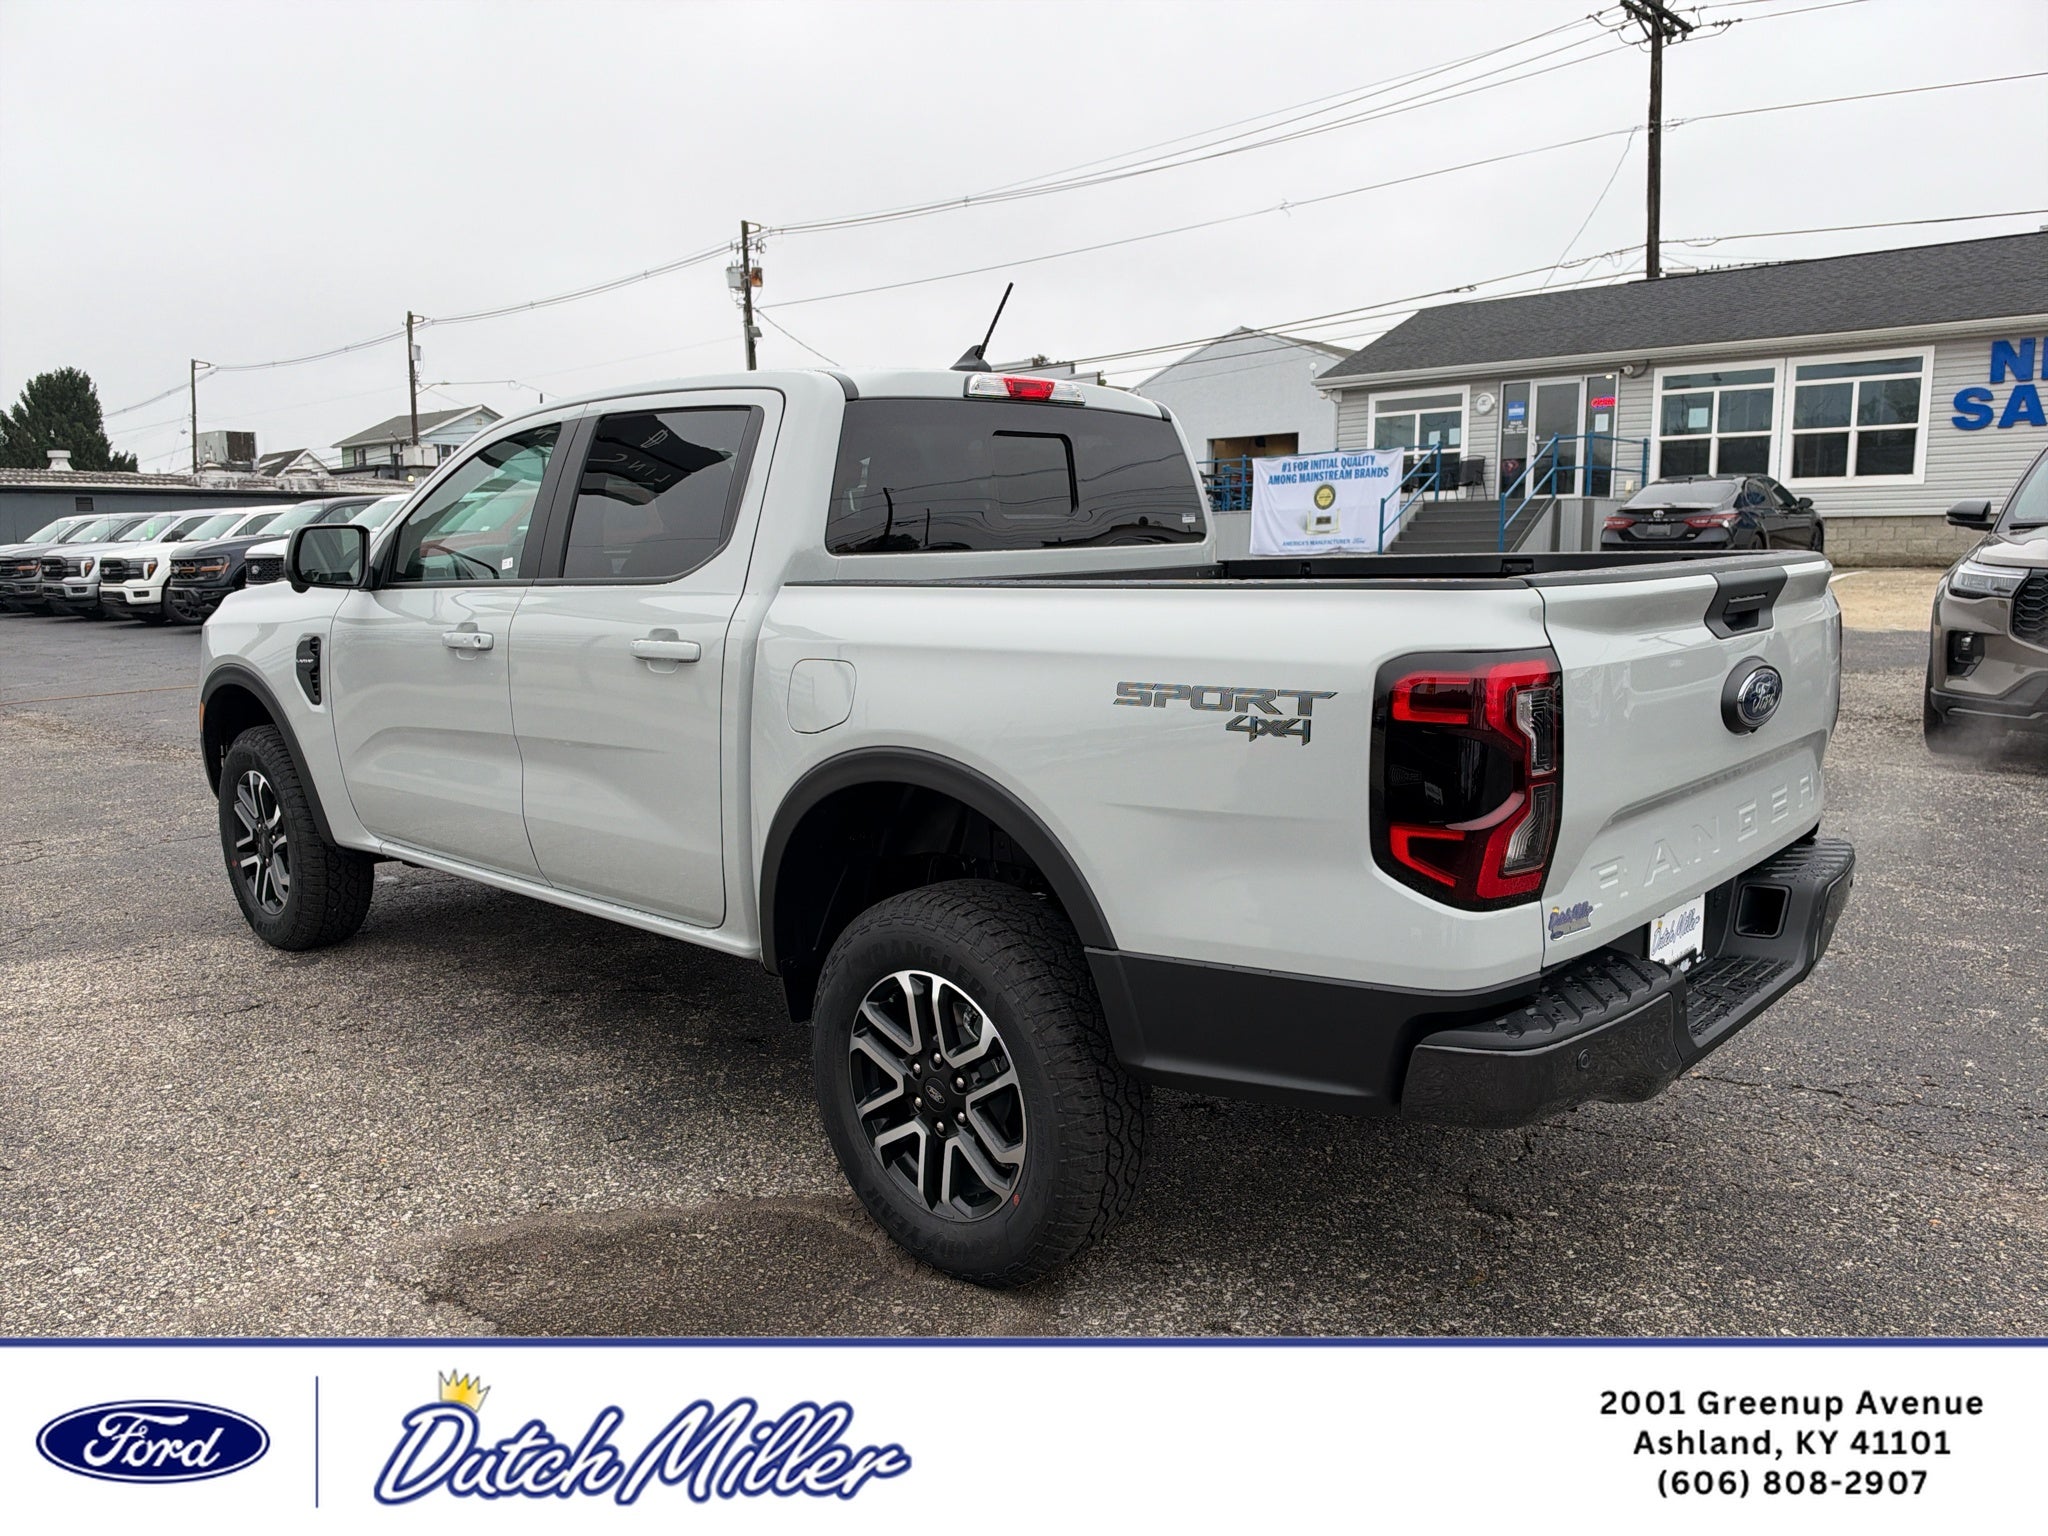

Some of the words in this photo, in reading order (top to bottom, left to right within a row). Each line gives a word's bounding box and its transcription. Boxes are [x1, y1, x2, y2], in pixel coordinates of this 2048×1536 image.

[1990, 337, 2048, 385] N
[1267, 473, 1297, 485] AMONG
[1298, 469, 1352, 483] MAINSTREAM
[1354, 467, 1389, 479] BRANDS
[1281, 462, 1292, 473] #1
[1293, 460, 1309, 472] FOR
[1310, 458, 1338, 470] INITIAL
[1341, 455, 1376, 468] QUALITY
[1112, 681, 1339, 717] SPORT
[1751, 680, 1777, 713] Ford
[1225, 714, 1311, 746] 4x4
[1591, 770, 1816, 909] RANGER
[1651, 919, 1677, 957] Dutch
[1674, 907, 1701, 939] Miller
